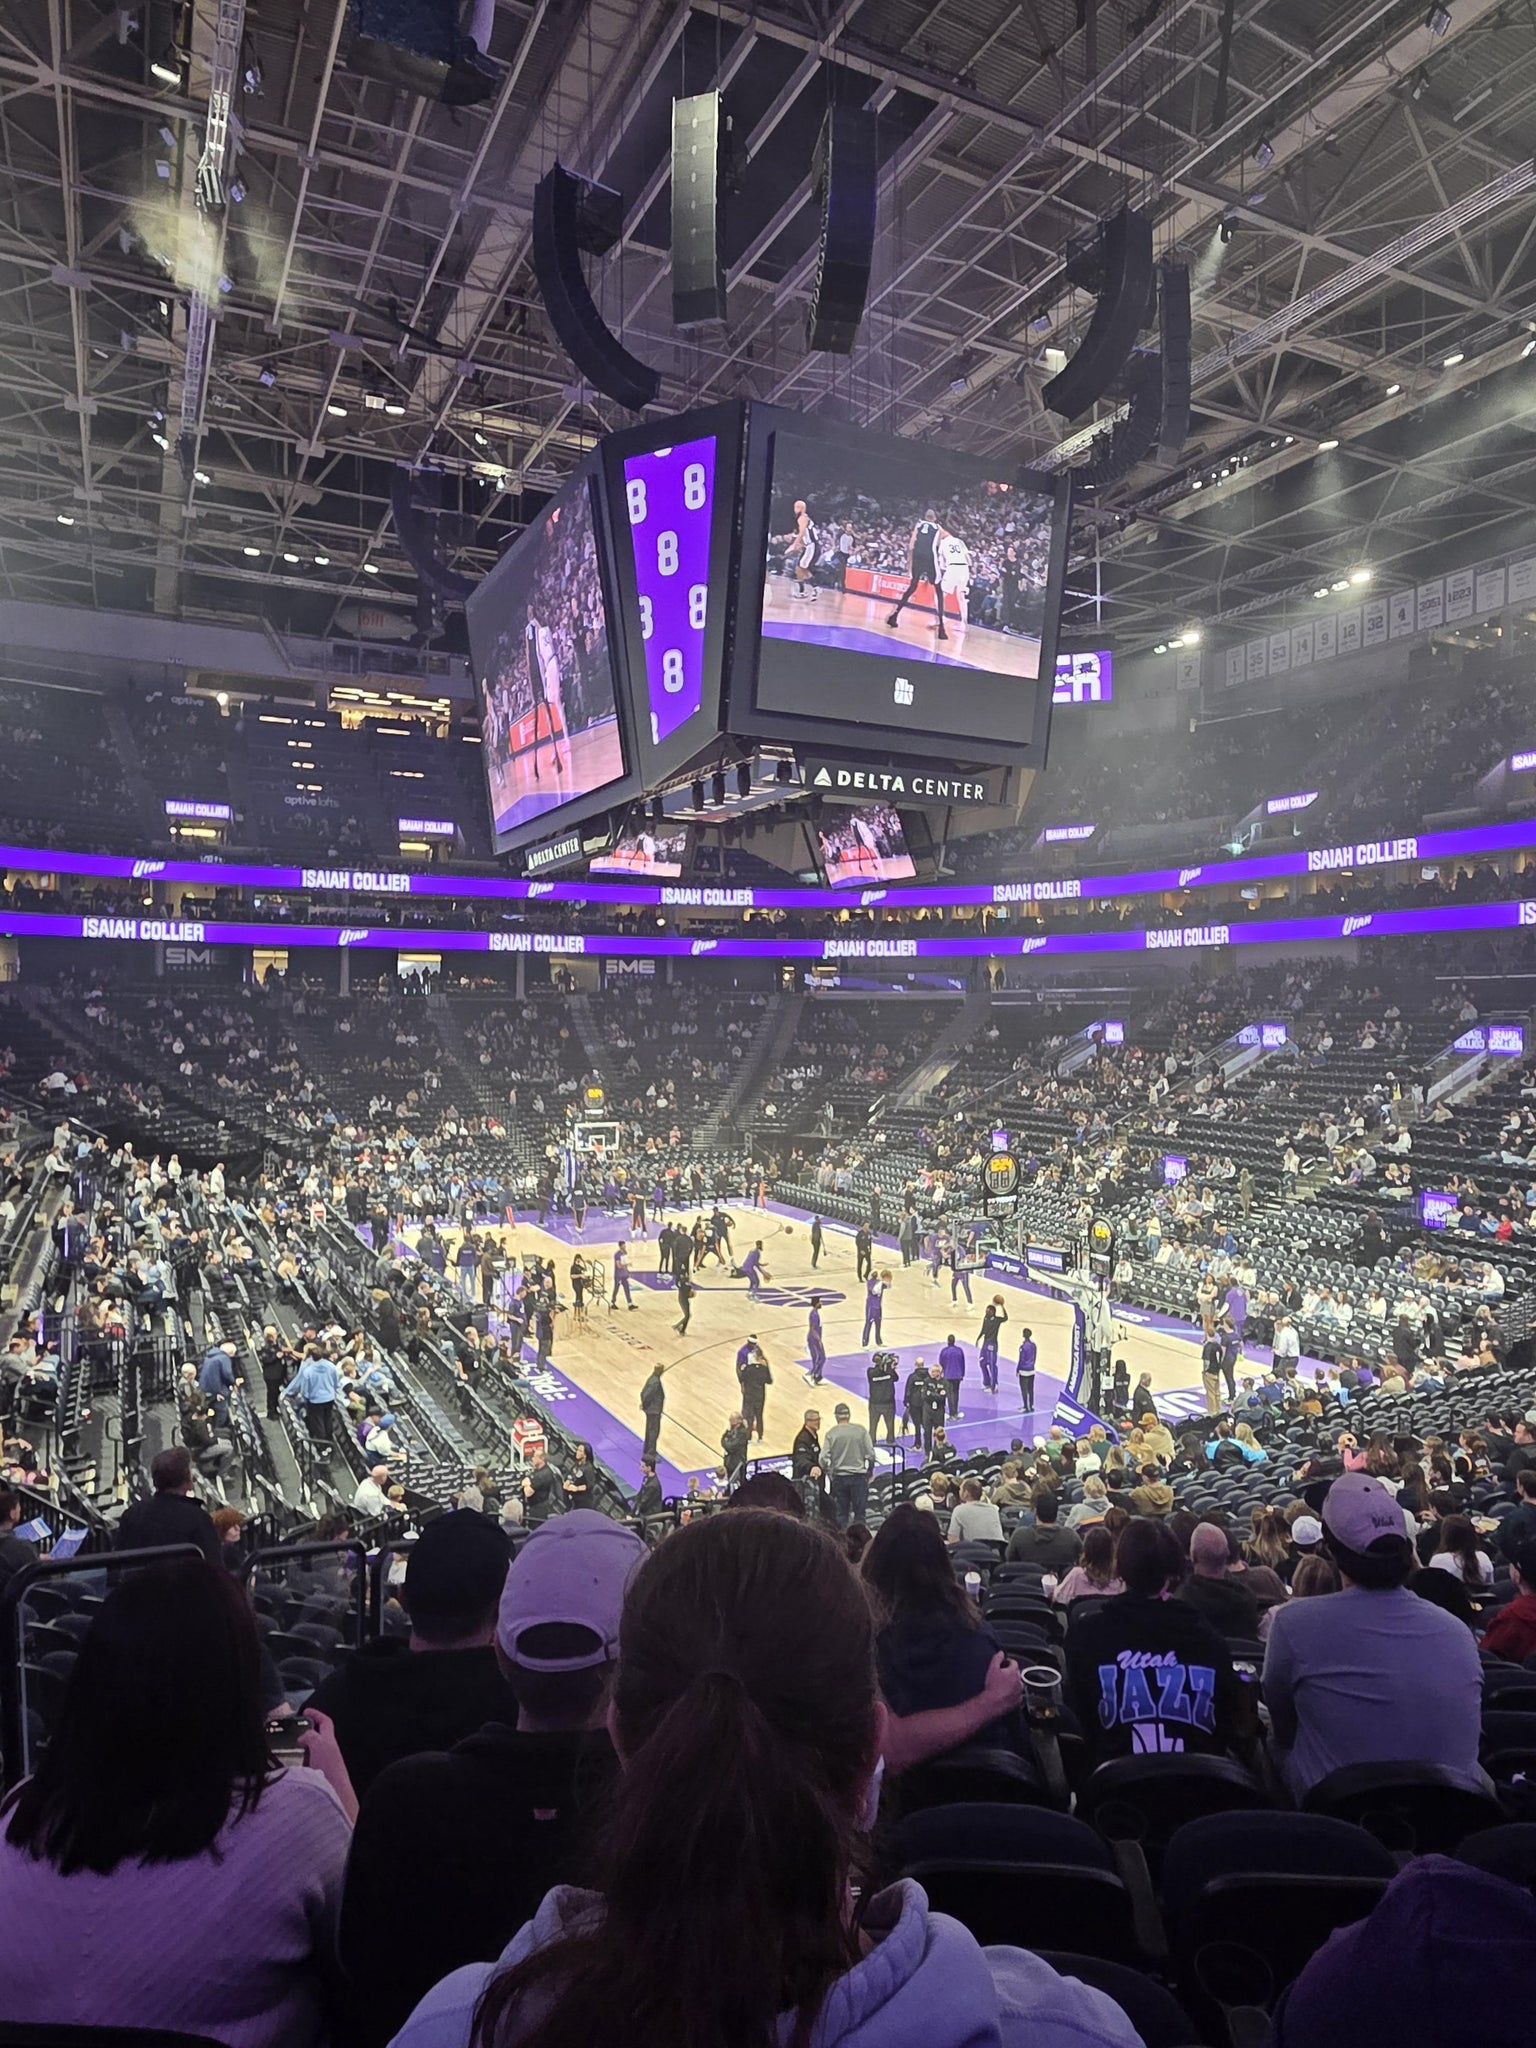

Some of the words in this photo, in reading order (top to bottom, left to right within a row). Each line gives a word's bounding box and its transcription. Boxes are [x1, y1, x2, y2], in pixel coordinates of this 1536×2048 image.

[684, 463, 706, 510] 8
[626, 478, 647, 525] 8
[657, 530, 679, 576] 8
[689, 584, 708, 629] 8
[663, 649, 684, 693] 8
[837, 770, 905, 792] DELTA
[912, 778, 984, 800] CENTER
[533, 847, 554, 867] DELTA
[554, 837, 580, 859] CENTER
[1308, 846, 1353, 871] ISAIAH
[1356, 838, 1418, 865] COLLIER
[302, 869, 349, 889] ISAIAH
[353, 872, 410, 892] COLLIER
[993, 884, 1032, 901] ISAIAH
[1034, 880, 1081, 900] COLLIER
[661, 888, 701, 904] ISAIAH
[703, 889, 753, 906] COLLIER
[82, 918, 136, 939] ISAIAH
[140, 922, 204, 942] COLLIER
[489, 933, 531, 951] ISAIAH
[533, 934, 584, 953] COLLIER
[1146, 928, 1182, 948] ISAIAH
[1184, 925, 1229, 946] COLLIER
[825, 940, 865, 957] ISAIAH
[867, 939, 917, 957] COLLIER
[606, 959, 655, 974] SME
[1117, 1650, 1178, 1669] Utah
[1098, 1664, 1216, 1735] JAZZ
